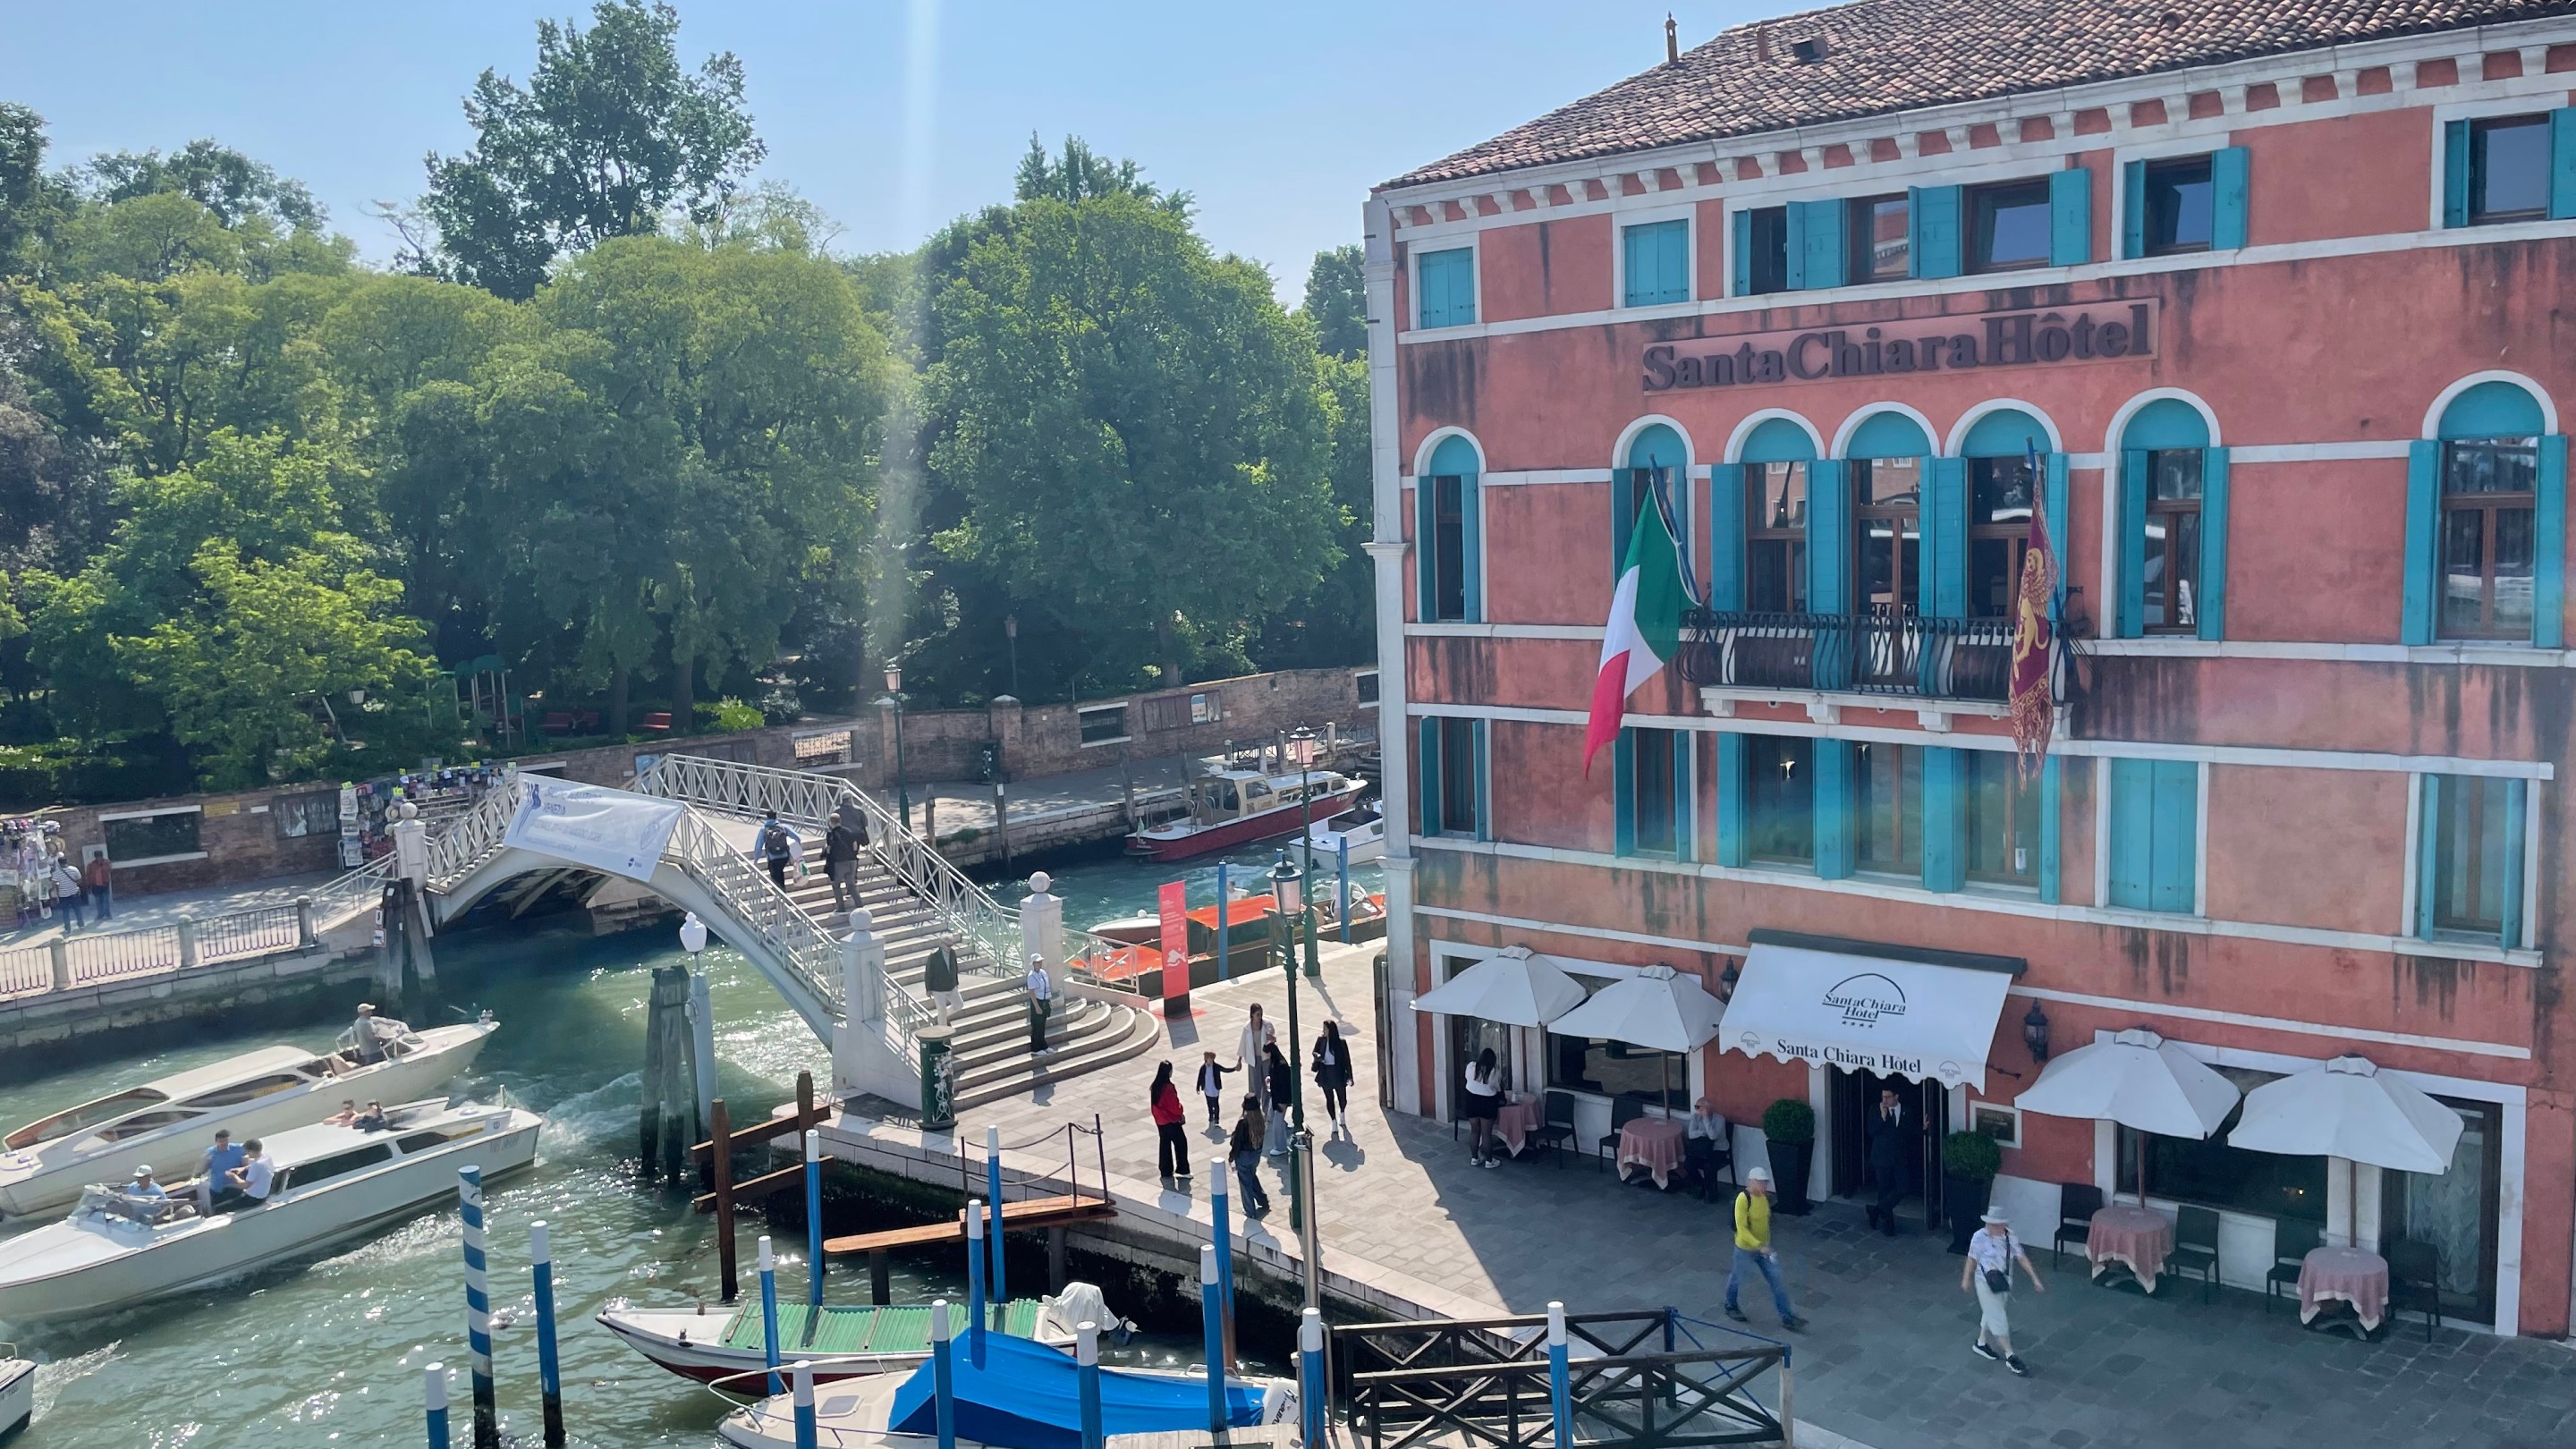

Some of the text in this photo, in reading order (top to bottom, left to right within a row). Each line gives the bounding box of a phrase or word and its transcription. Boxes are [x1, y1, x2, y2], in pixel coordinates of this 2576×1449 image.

[1777, 1038, 1818, 1058] Santa
[1824, 1046, 1876, 1067] Chiara
[1882, 1054, 1921, 1073] Hôtel
